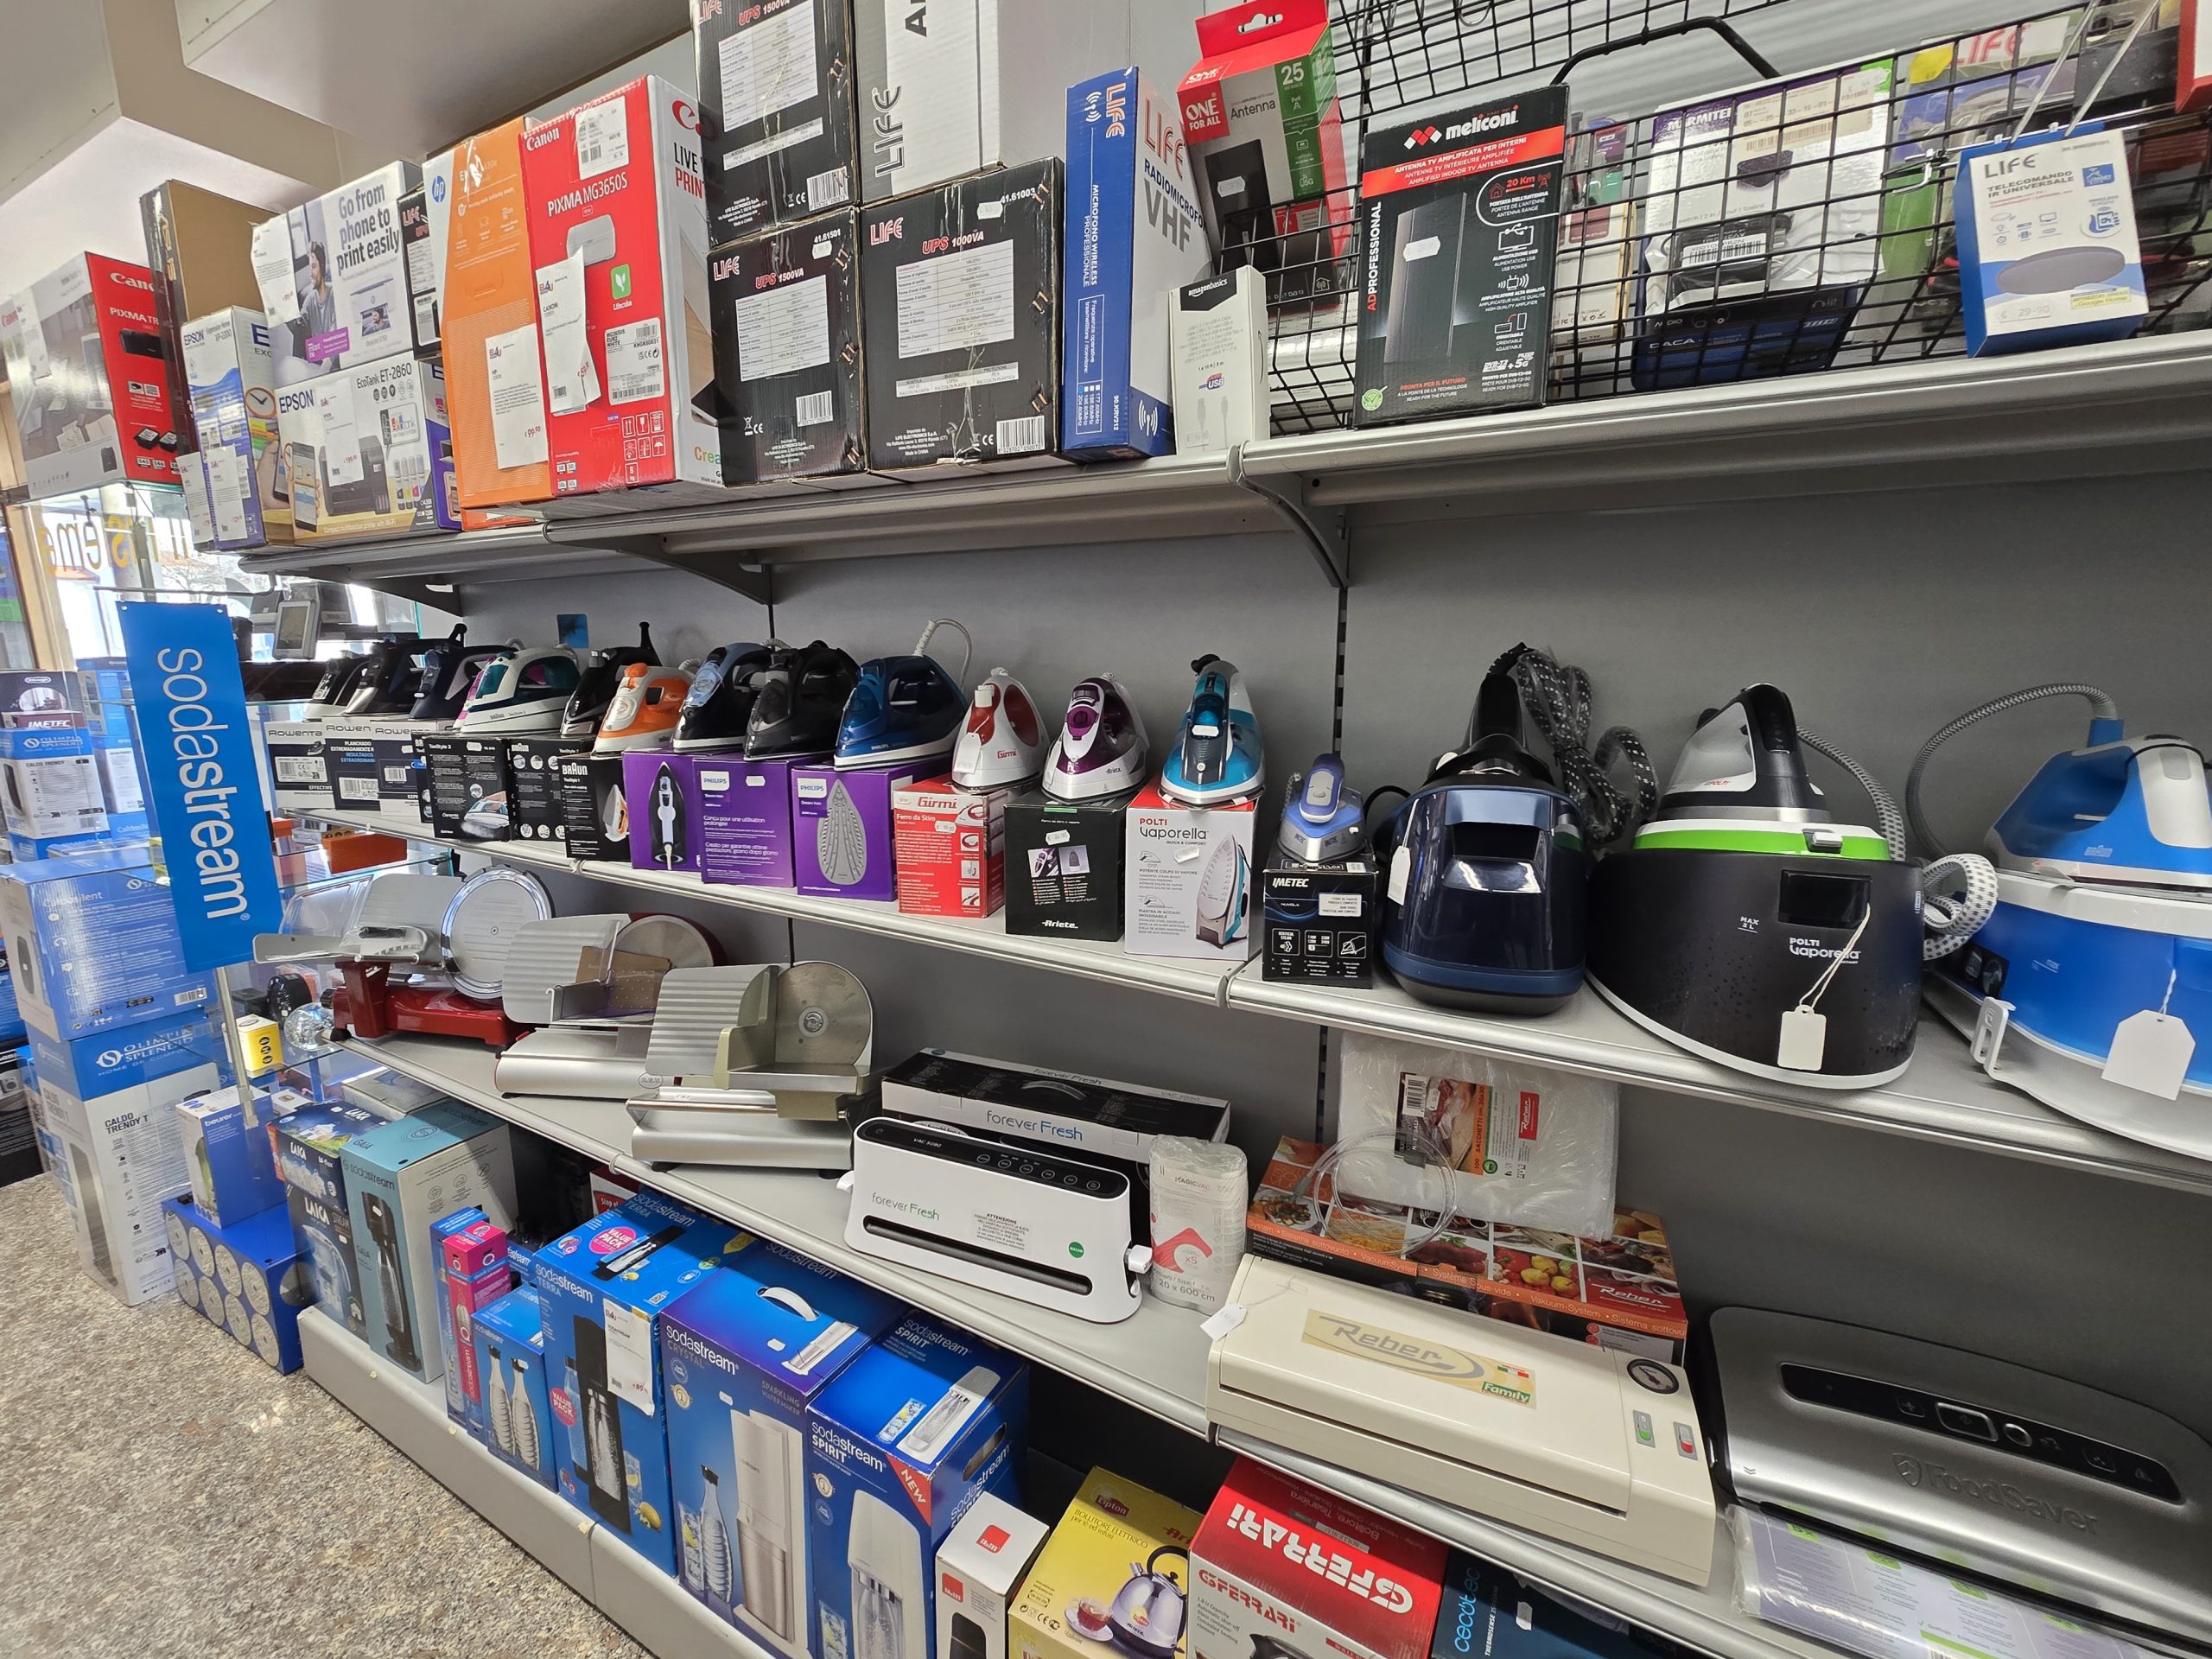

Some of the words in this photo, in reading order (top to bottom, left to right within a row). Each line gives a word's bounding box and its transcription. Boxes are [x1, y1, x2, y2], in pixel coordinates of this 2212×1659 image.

[739, 4, 761, 26] UPS
[1281, 62, 1305, 86] 25
[1106, 83, 1126, 138] LIFE
[1185, 97, 1219, 120] ONE
[1230, 99, 1276, 120] Antenna
[872, 86, 905, 177] LIFE
[1189, 119, 1206, 131] FOR
[1206, 116, 1221, 128] ALL
[1446, 107, 1520, 140] meliconi
[526, 127, 561, 152] Canon
[1144, 98, 1184, 181] LIFE
[673, 142, 698, 174] LIVE
[1395, 161, 1427, 174] ANTENNA
[1427, 157, 1437, 166] TV
[1438, 148, 1483, 164] AMPLIFICATA
[1484, 143, 1497, 152] PER
[1497, 137, 1527, 149] INTERNI
[1404, 168, 1434, 179] ANTENNE
[1443, 156, 1479, 170] INTÉRIEURE
[1480, 148, 1515, 162] AMPLIFIÉE
[1984, 153, 2038, 180] LIFE
[1408, 173, 1440, 186] AMPLIFIED
[1441, 167, 1467, 178] INDOOR
[1478, 157, 1509, 169] ANTENNA
[1506, 179, 1518, 188] 20
[1520, 175, 1535, 185] Km
[1986, 170, 2073, 192] TELECOMANDO
[547, 192, 582, 217] PIXMA
[582, 171, 628, 204] MG3650S
[1001, 188, 1036, 204] 41.61003
[1988, 190, 2001, 199] IR
[2002, 176, 2075, 195] UNIVERSALE
[338, 196, 355, 219] Go
[355, 184, 385, 211] from
[1491, 205, 1510, 213] PORTÉE
[1144, 177, 1192, 253] VHF
[1497, 209, 1521, 218] ANTENNA
[340, 215, 376, 251] phone
[377, 207, 391, 229] to
[813, 228, 842, 243] 41.61501
[870, 217, 904, 245] LIFE
[336, 240, 365, 276] print
[367, 229, 399, 259] easily
[922, 236, 949, 255] UPS
[951, 230, 984, 248] 1000VA
[1367, 201, 1382, 311] ADPROFESSIONAL
[713, 256, 741, 281] LIFE
[755, 272, 777, 289] UPS
[778, 268, 804, 283] 1500VA
[110, 308, 147, 323] PIXMA
[543, 302, 559, 313] CANON
[184, 330, 205, 346] EPSON
[380, 363, 411, 383] ET-2860
[1441, 377, 1465, 385] FUTURO
[279, 389, 314, 413] EPSON
[28, 720, 72, 728] IMETEC
[511, 743, 530, 752] BRAUN
[997, 748, 1016, 760] Girmi
[562, 762, 588, 776] BRAUN
[157, 648, 248, 918] sodastream
[800, 784, 824, 792] PHILIPS
[918, 797, 957, 809] Girmi
[703, 815, 719, 823] Conçu
[720, 817, 732, 825] pour
[1140, 817, 1168, 826] POLTI
[748, 849, 762, 857] dopo
[1272, 877, 1310, 888] IMETEC
[1042, 920, 1079, 929] Ariete
[1740, 916, 1759, 926] MAX
[1789, 937, 1820, 948] POLTI
[105, 1111, 134, 1128] CALDO
[204, 1111, 233, 1127] beurer
[987, 1110, 1037, 1131] forever
[1039, 1120, 1084, 1141] Fresh
[1520, 1096, 1535, 1133] Reber
[105, 1118, 141, 1135] TRENDY
[290, 1142, 307, 1160] LAICA
[926, 1140, 942, 1148] 5090
[349, 1161, 395, 1192] sodastream
[304, 1197, 330, 1226] LAICA
[625, 1200, 654, 1218] TERRA
[632, 1192, 696, 1227] sodastream
[872, 1192, 908, 1212] forever
[910, 1203, 940, 1222] Fresh
[986, 1212, 1017, 1224] ATTENZIONE
[599, 1233, 625, 1249] PACK
[607, 1228, 632, 1244] VALUE
[766, 1242, 838, 1280] sodastream
[535, 1262, 594, 1304] sodastream
[536, 1276, 563, 1298] TERRA
[1281, 1230, 1311, 1245] Sistema
[1313, 1240, 1350, 1256] sottovuoto
[1431, 1268, 1466, 1284] Système
[1529, 1294, 1601, 1319] Vakuum-System
[1611, 1313, 1649, 1328] Sistema
[1179, 1286, 1199, 1298] 600
[1590, 1282, 1672, 1310] Reber
[895, 1326, 931, 1349] SPIRIT
[904, 1318, 969, 1356] sodastream
[1319, 1315, 1458, 1370] Reber
[666, 1325, 736, 1376] sodastream
[761, 1380, 800, 1408] SPARKLING
[1483, 1382, 1530, 1403] Family
[811, 1421, 884, 1472] sodastream
[811, 1434, 848, 1463] SPIRIT
[900, 1468, 927, 1504] NEW
[951, 1445, 1010, 1521] sodastream
[1923, 1461, 2099, 1535] FoodSaver
[1074, 1509, 1111, 1533] BOLLITORE
[1111, 1526, 1148, 1548] ELETTRICO
[1209, 1604, 1230, 1619] Capacity
[1454, 1567, 1480, 1653] cecotec
